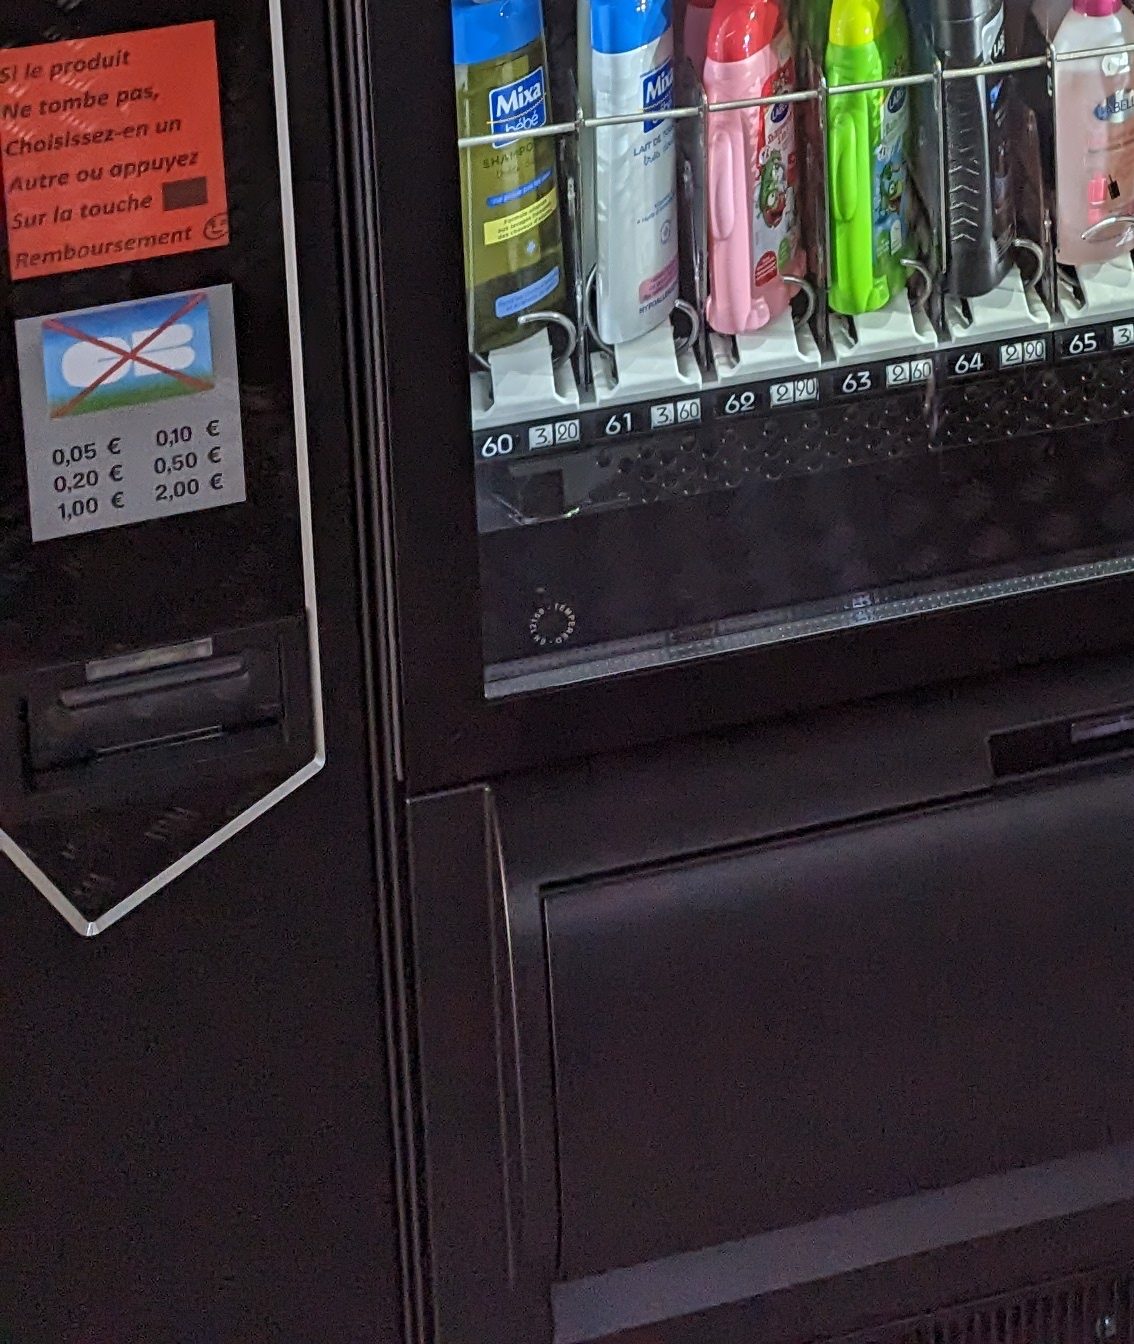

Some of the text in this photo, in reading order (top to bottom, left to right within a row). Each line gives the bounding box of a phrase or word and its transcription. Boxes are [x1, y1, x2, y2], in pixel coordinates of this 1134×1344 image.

[23, 62, 43, 81] le
[49, 49, 132, 80] produit
[39, 92, 109, 118] tombe
[116, 86, 161, 104] pas,
[496, 81, 541, 118] Mixa
[5, 118, 182, 158] Choisissez-en un
[8, 150, 200, 195] Autre ou appuyez
[11, 193, 153, 231] Sur la touche
[15, 225, 193, 270] Remboursement
[1069, 332, 1097, 354] 65
[842, 371, 872, 393] 63
[52, 420, 219, 467] 0,05 € 0,10 €
[482, 433, 514, 457] 60
[53, 446, 222, 494] 0,20 € 0,50 €
[58, 473, 224, 521] 1,00 € 2,00 €
